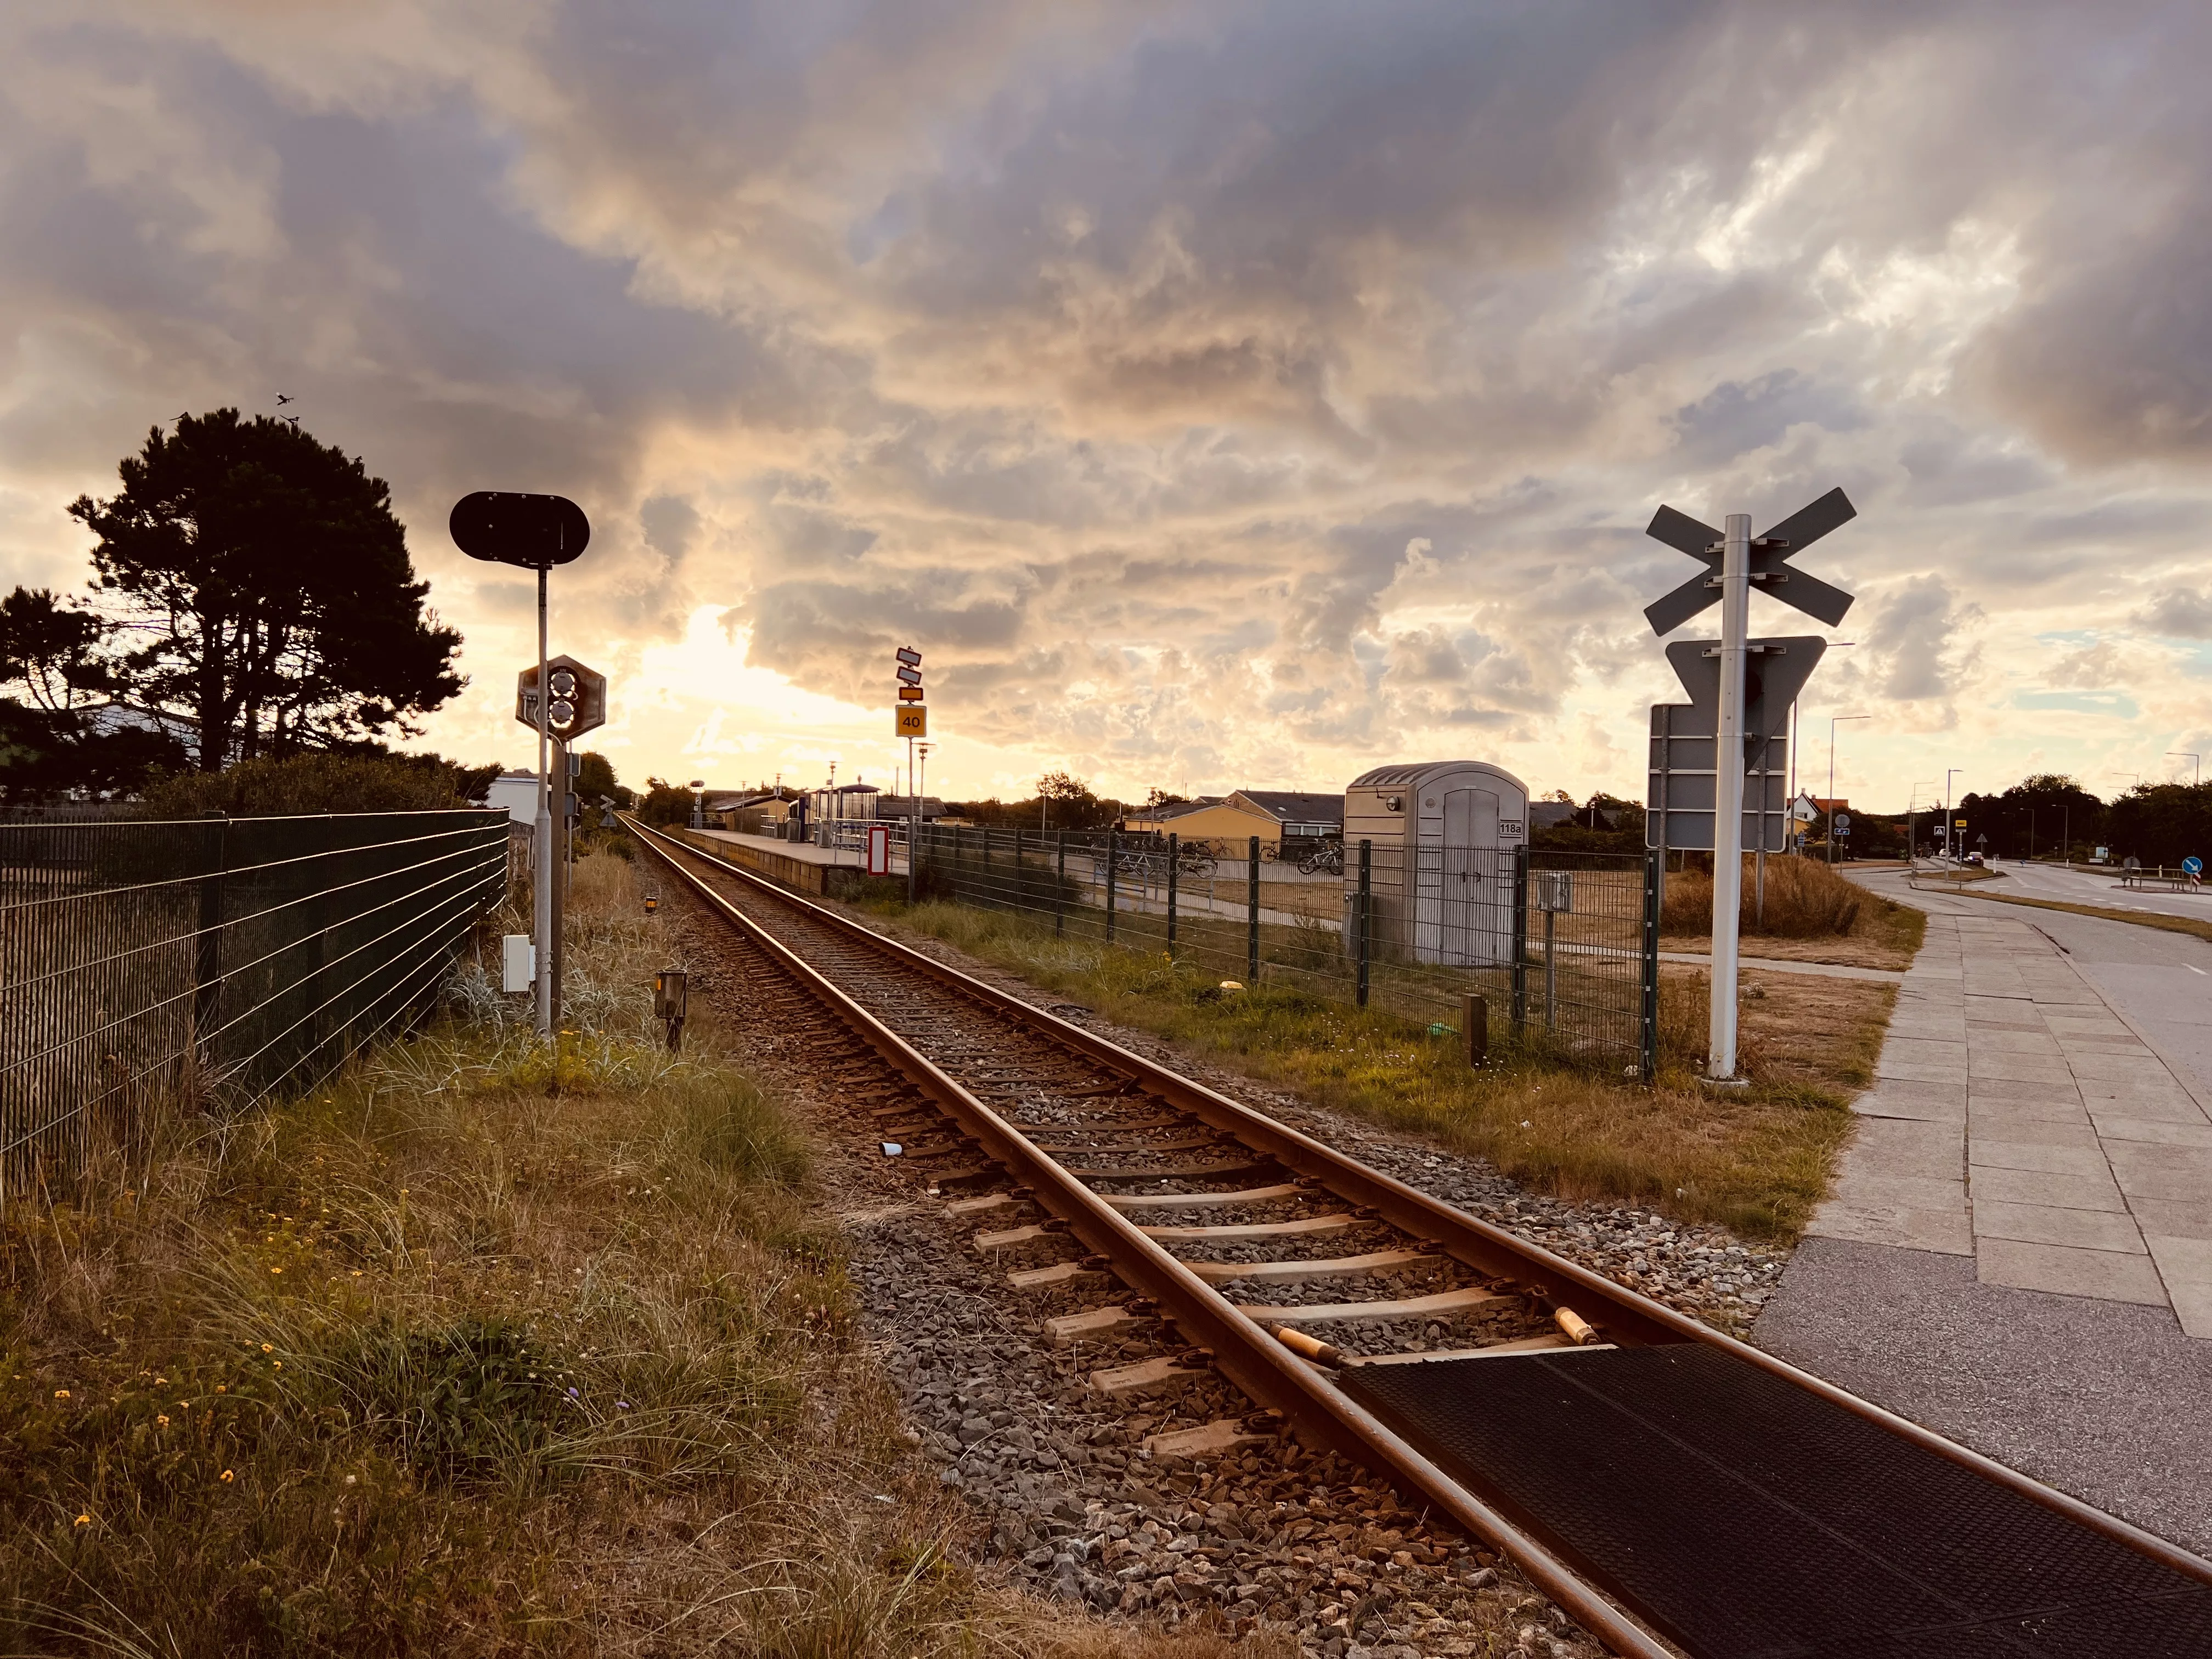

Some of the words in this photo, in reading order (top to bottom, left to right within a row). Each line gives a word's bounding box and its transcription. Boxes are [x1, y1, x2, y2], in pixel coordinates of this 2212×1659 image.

[902, 716, 920, 727] 40
[776, 787, 779, 795] 1
[1500, 824, 1521, 833] 118a
